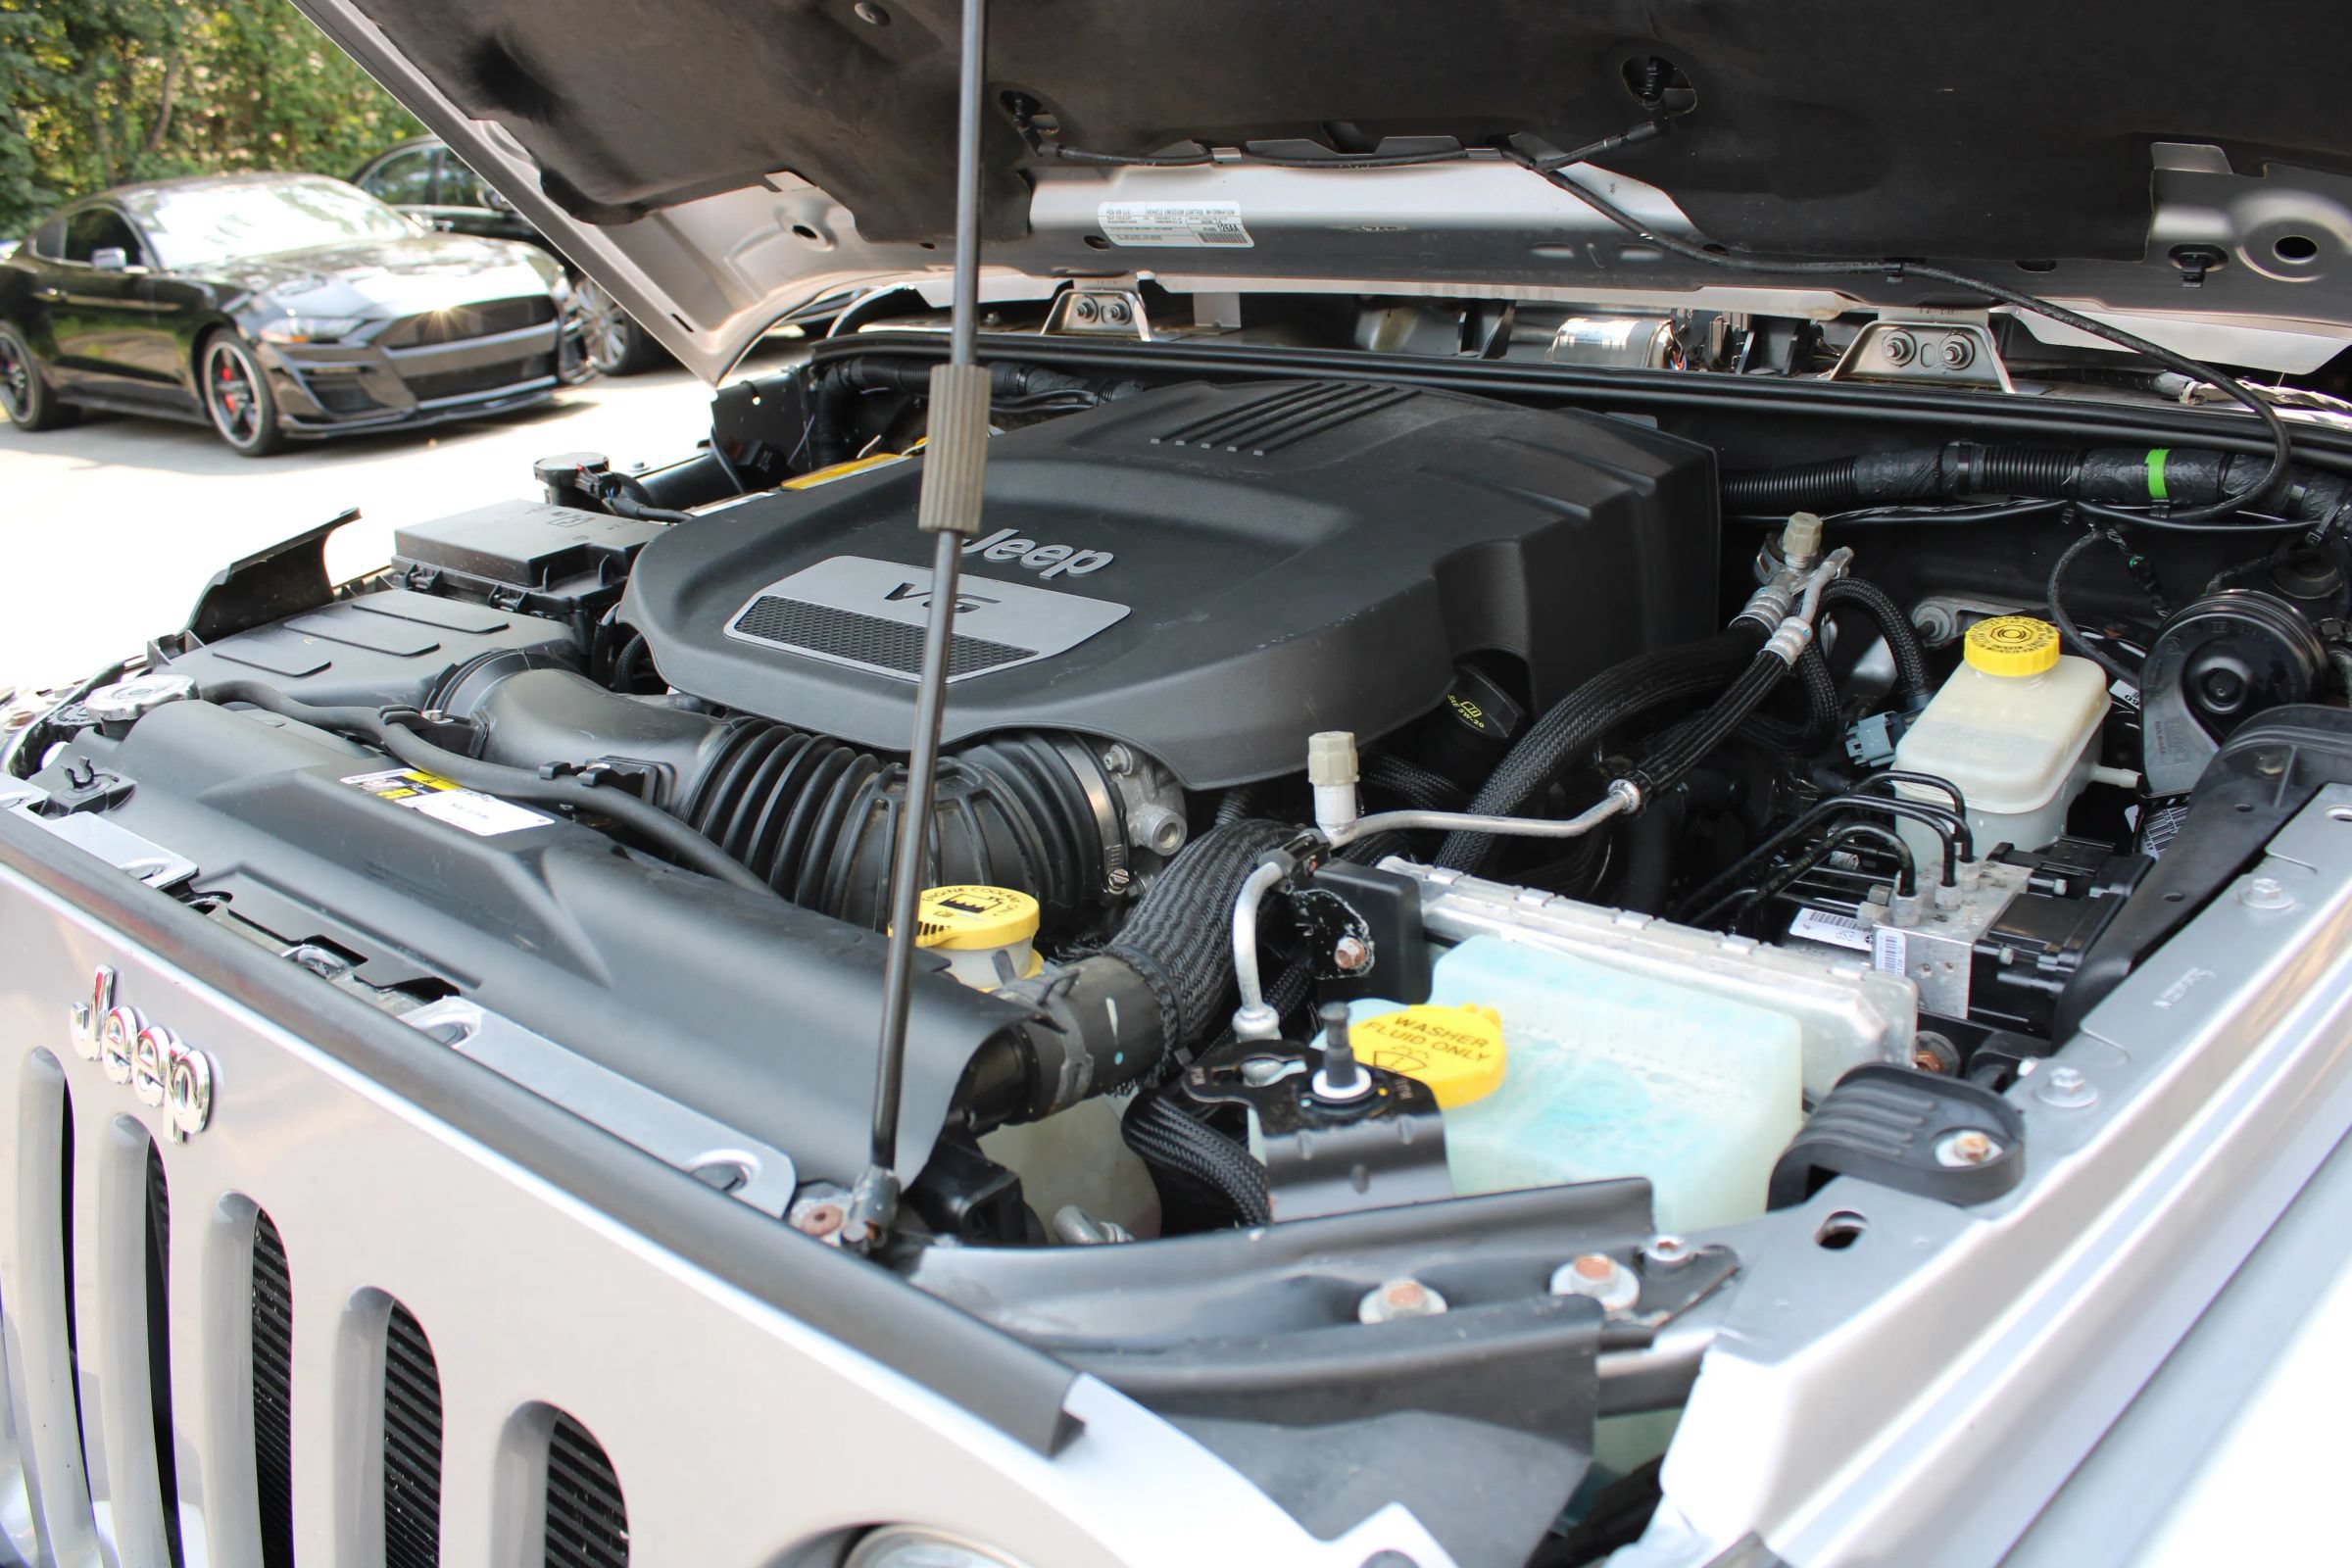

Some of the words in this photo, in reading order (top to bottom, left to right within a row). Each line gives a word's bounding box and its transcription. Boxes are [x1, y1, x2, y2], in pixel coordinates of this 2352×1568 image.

[960, 528, 1114, 579] Jeep
[922, 887, 965, 902] ENGINE
[970, 887, 1020, 903] COOLANT
[1363, 1021, 1427, 1045] FLUID
[1431, 1042, 1492, 1061] ONLY
[1395, 1016, 1489, 1049] WASHER
[71, 964, 213, 1145] Jeep
